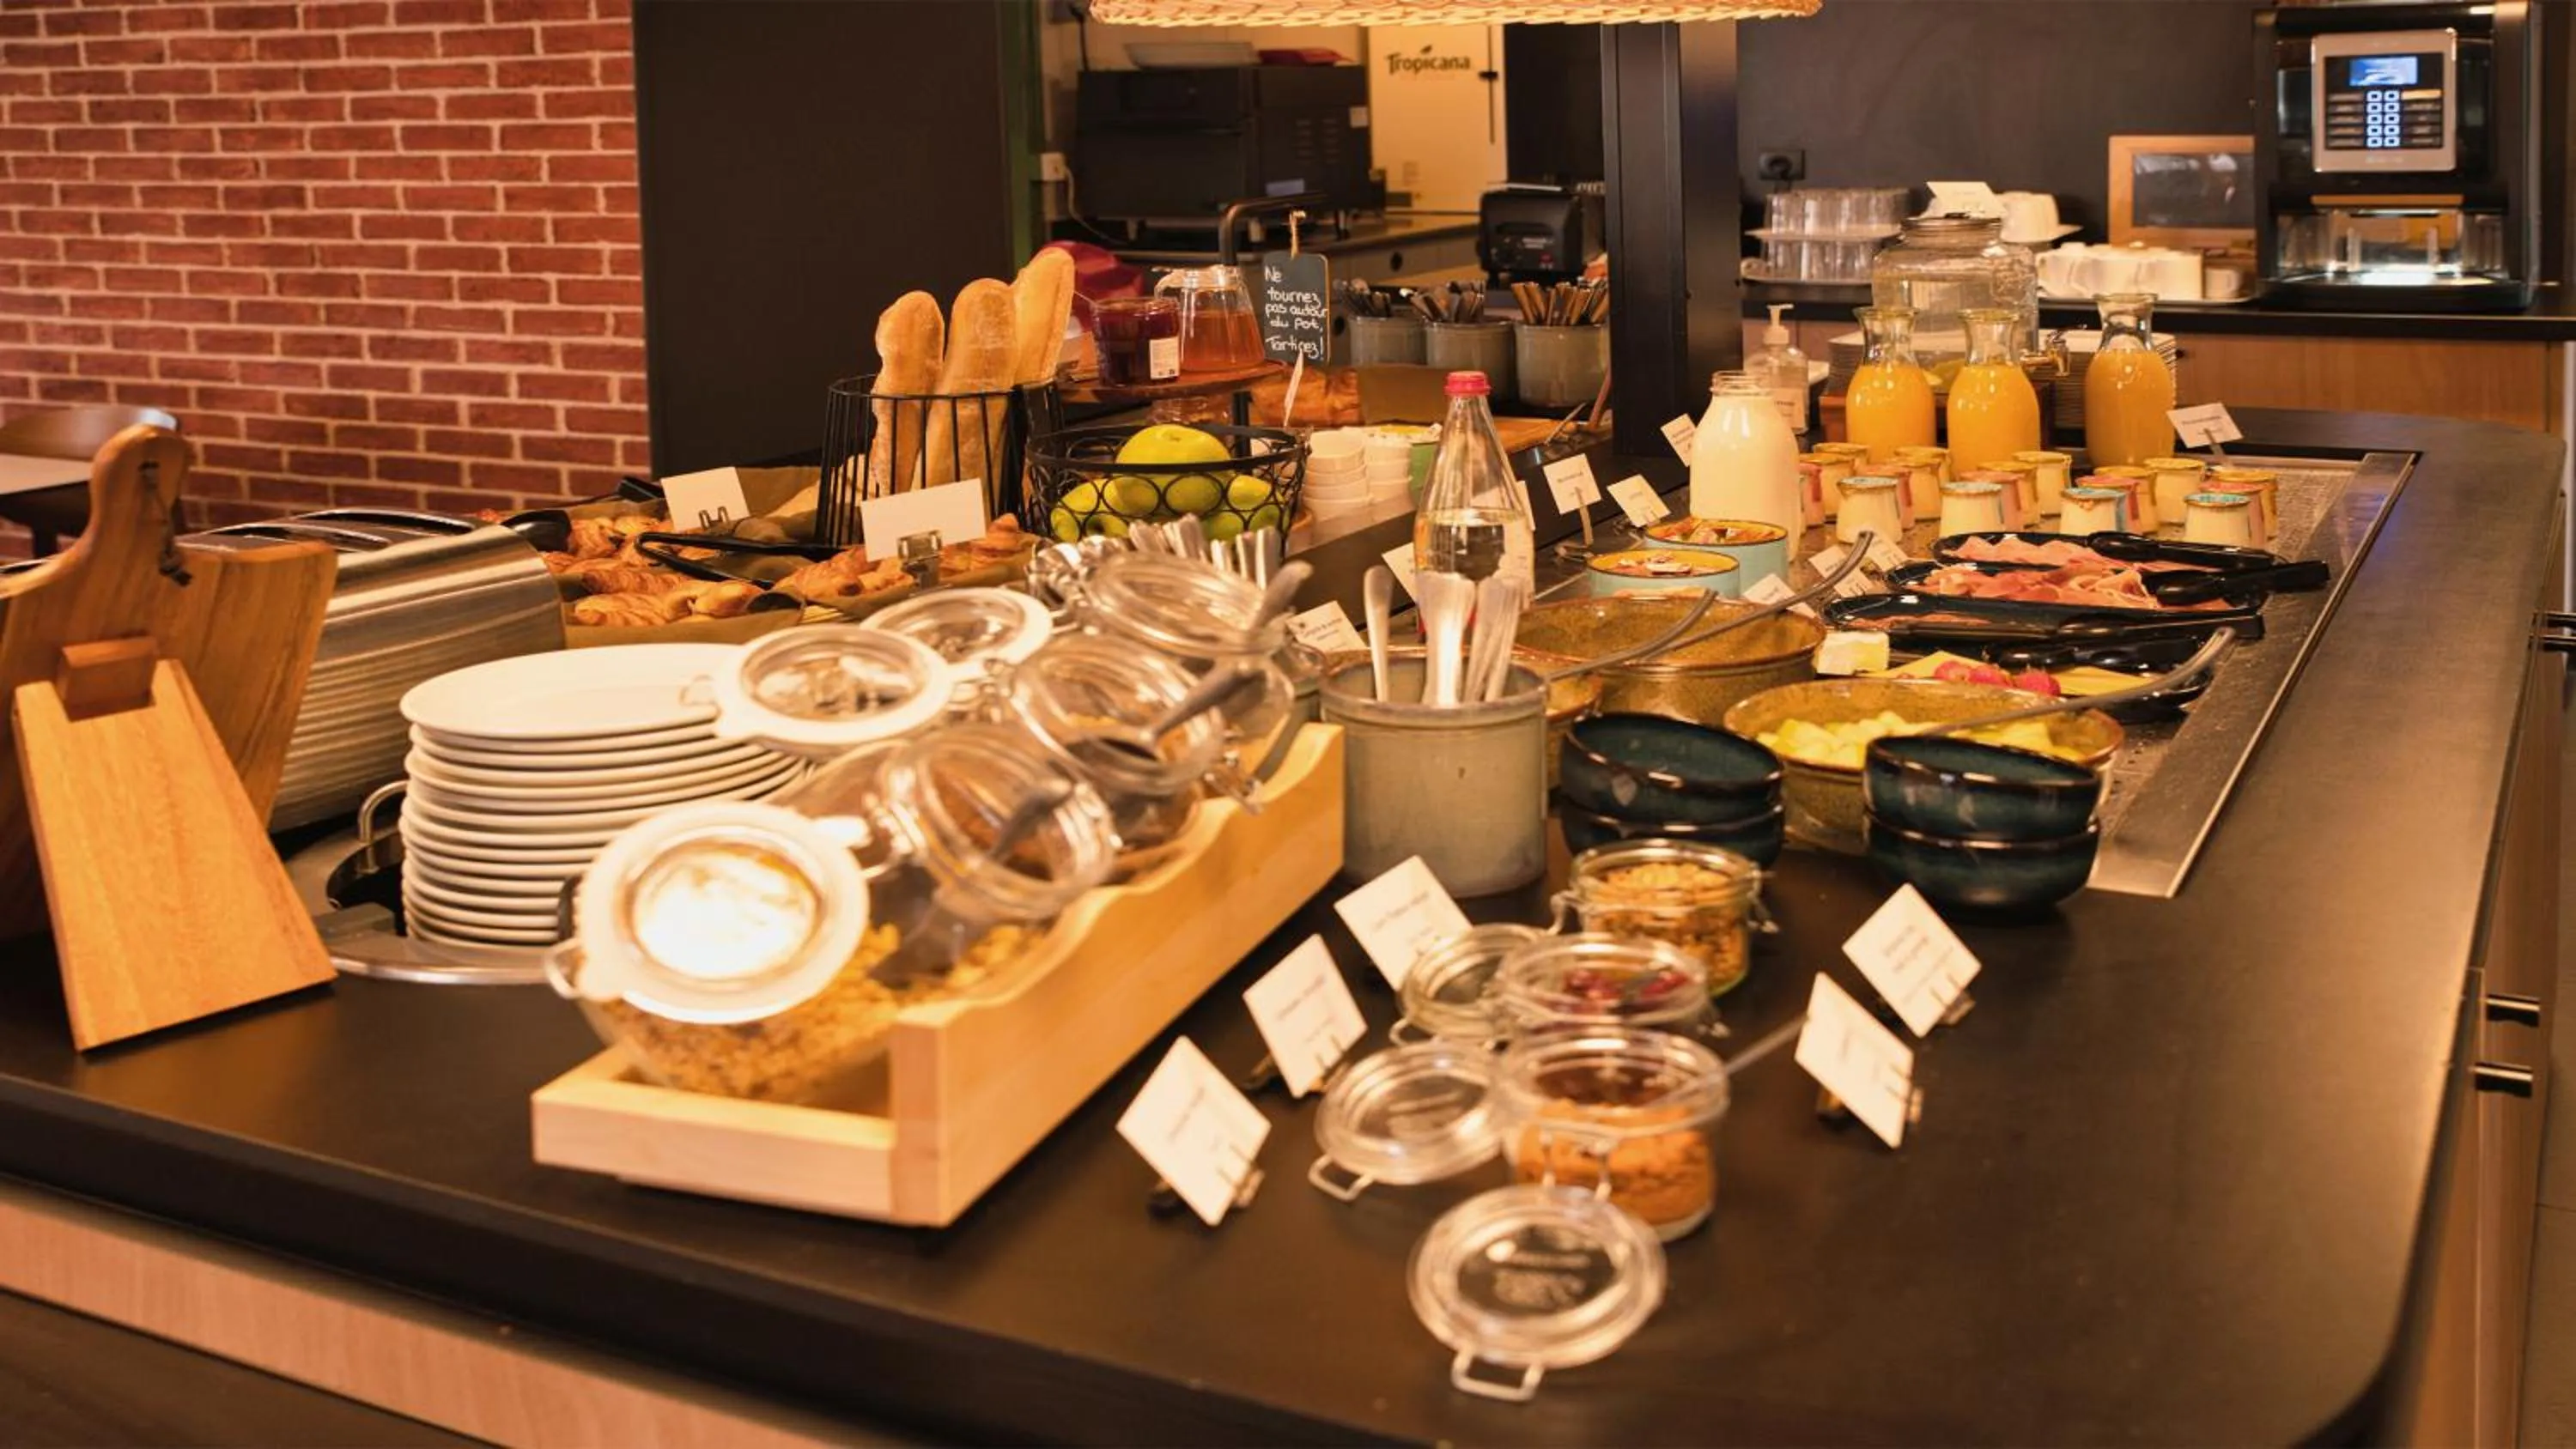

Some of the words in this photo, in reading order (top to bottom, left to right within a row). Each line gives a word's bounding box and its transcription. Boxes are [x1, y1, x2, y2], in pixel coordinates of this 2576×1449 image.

[1385, 50, 1471, 75] Tropicana
[1264, 265, 1282, 282] Ne
[1267, 286, 1321, 309] tournez
[1265, 303, 1287, 318] pas
[1290, 304, 1328, 318] autour
[1270, 315, 1289, 327] du
